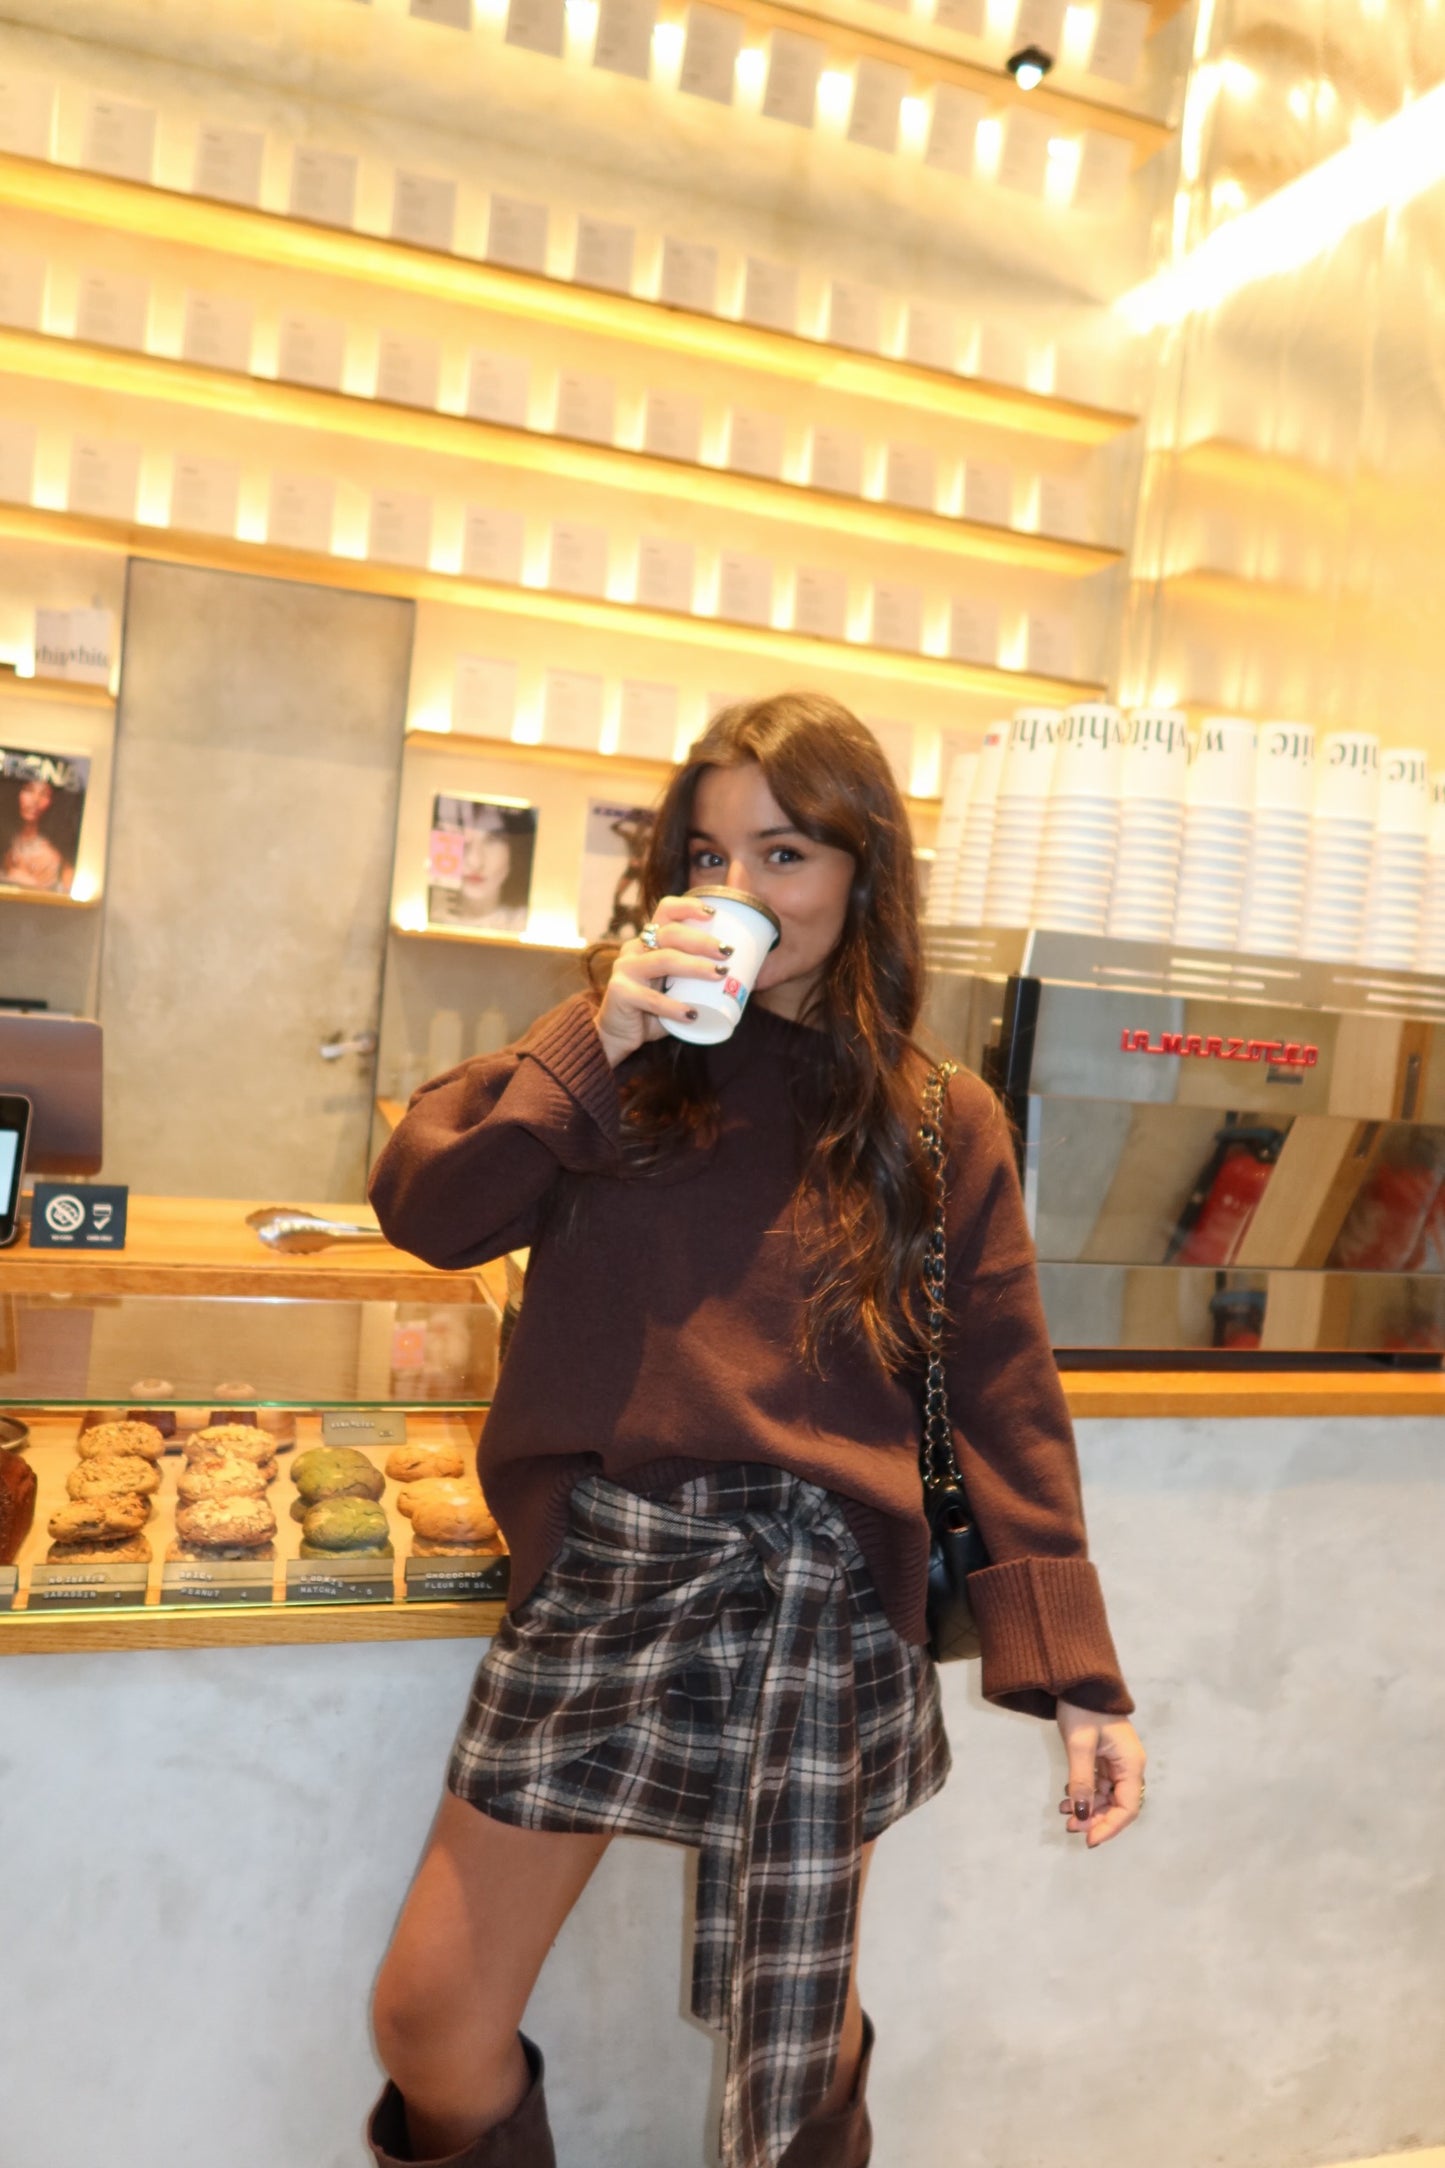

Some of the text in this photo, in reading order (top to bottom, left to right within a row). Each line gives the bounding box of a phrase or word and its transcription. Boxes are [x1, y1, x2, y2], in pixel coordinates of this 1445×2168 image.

[1120, 1028, 1150, 1053] LA
[180, 1587, 220, 1598] PEANUT
[300, 1586, 337, 1596] MATCHA
